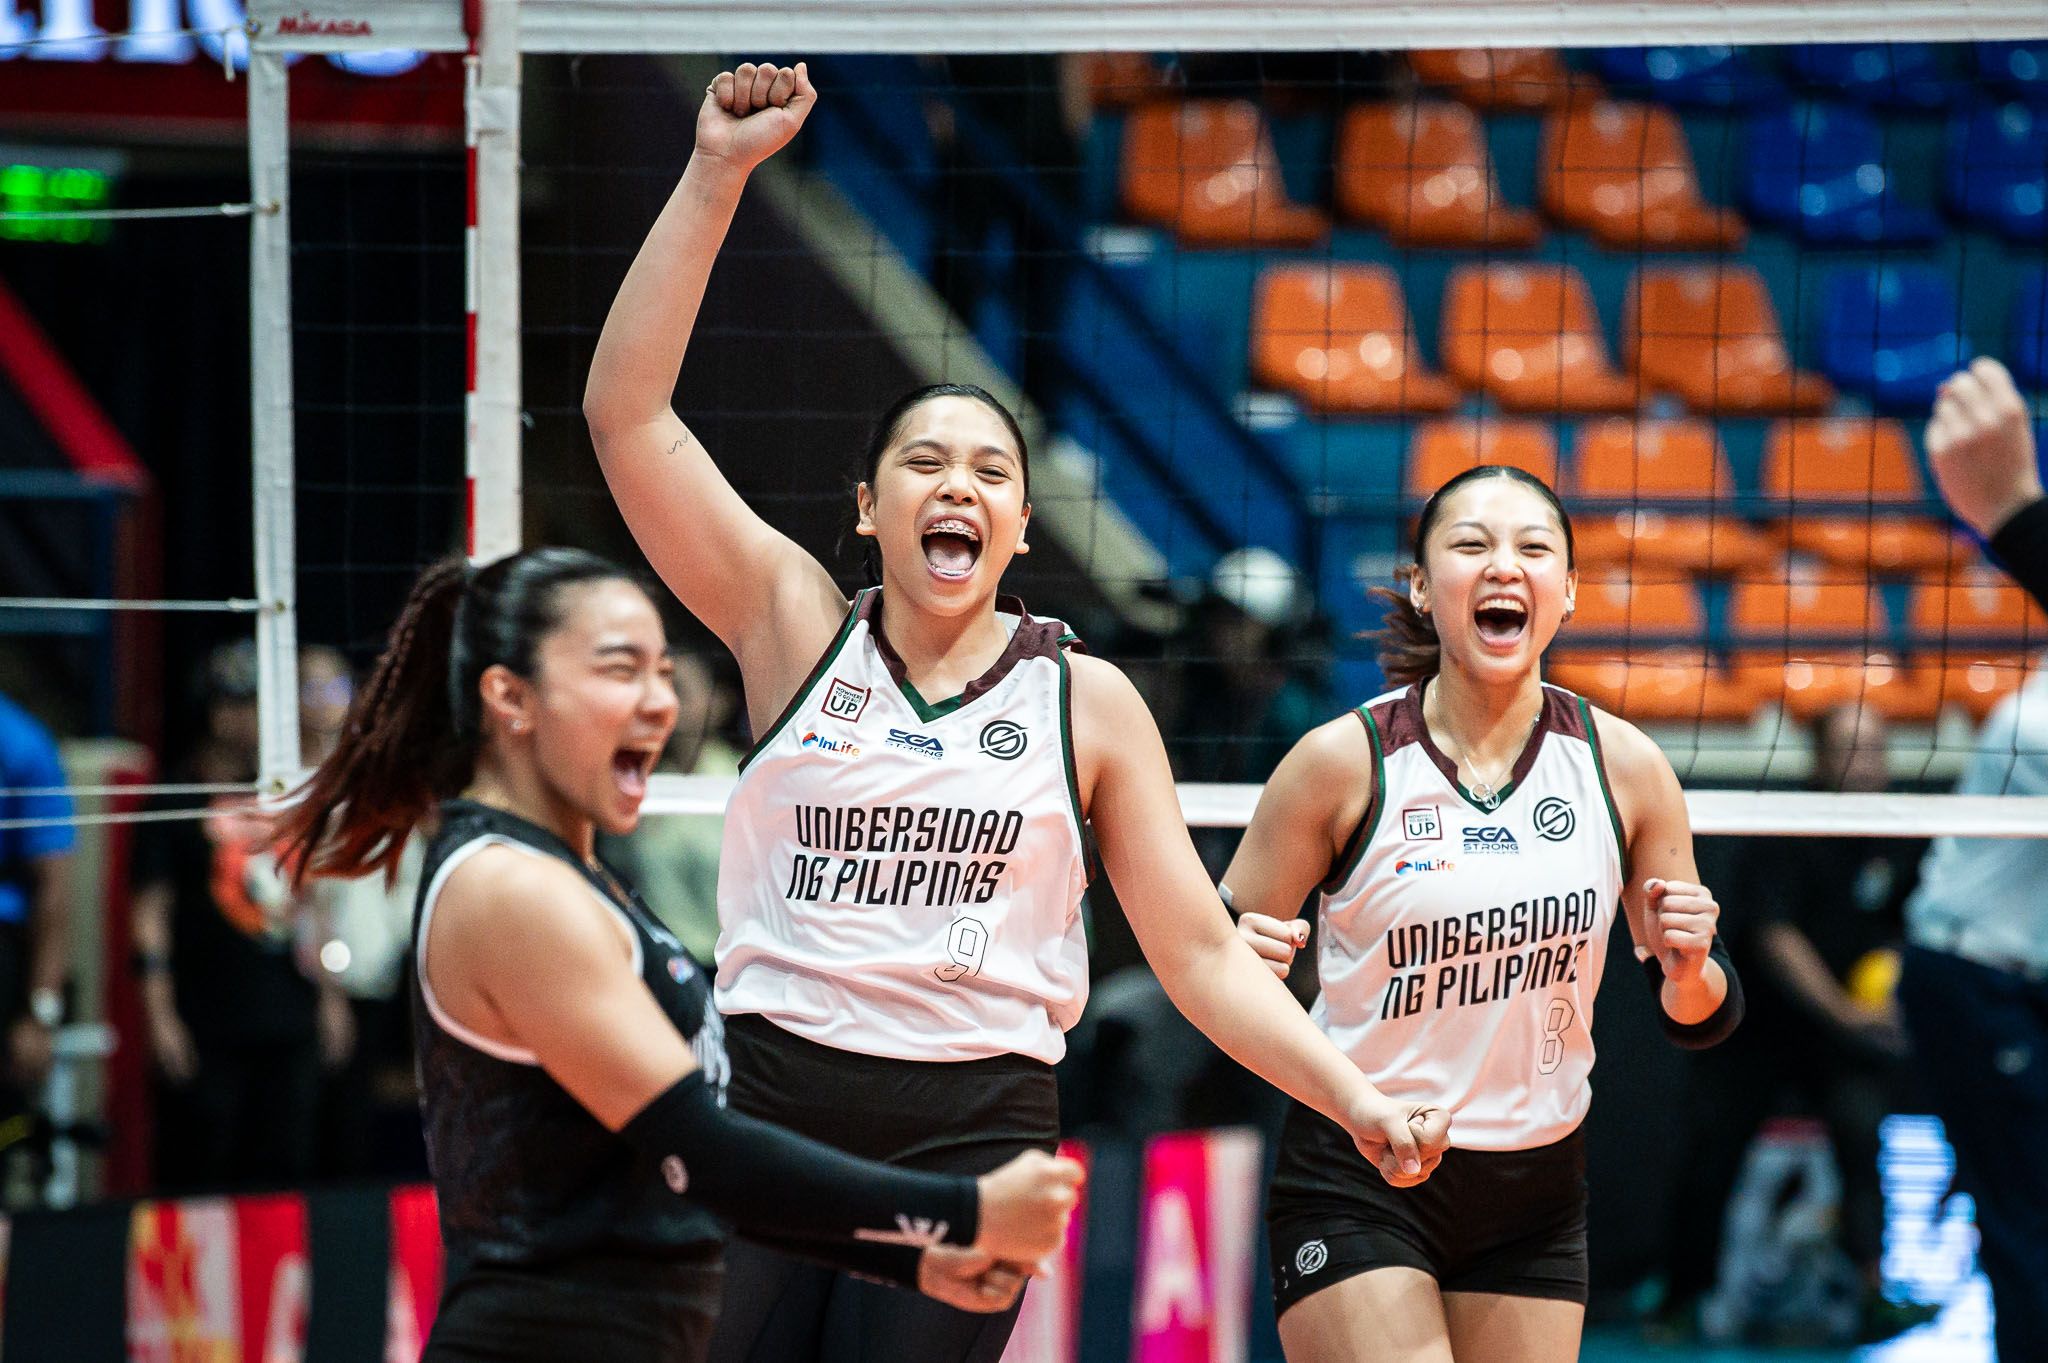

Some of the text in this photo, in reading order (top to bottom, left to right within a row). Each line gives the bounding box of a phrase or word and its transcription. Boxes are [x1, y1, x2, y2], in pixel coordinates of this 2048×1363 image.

[830, 695, 858, 715] UP
[818, 736, 860, 756] InLife
[887, 728, 944, 751] SGA
[795, 804, 1024, 855] UNIBERSIDAD
[1409, 822, 1436, 836] UP
[1462, 827, 1517, 842] SGA
[1463, 843, 1519, 851] STRONG
[1415, 859, 1455, 871] InLife
[786, 854, 1007, 907] NG PILIPINAS
[1387, 888, 1596, 969] UNIBERSIDAD
[1381, 974, 1426, 1020] NG
[1537, 998, 1576, 1076] 8
